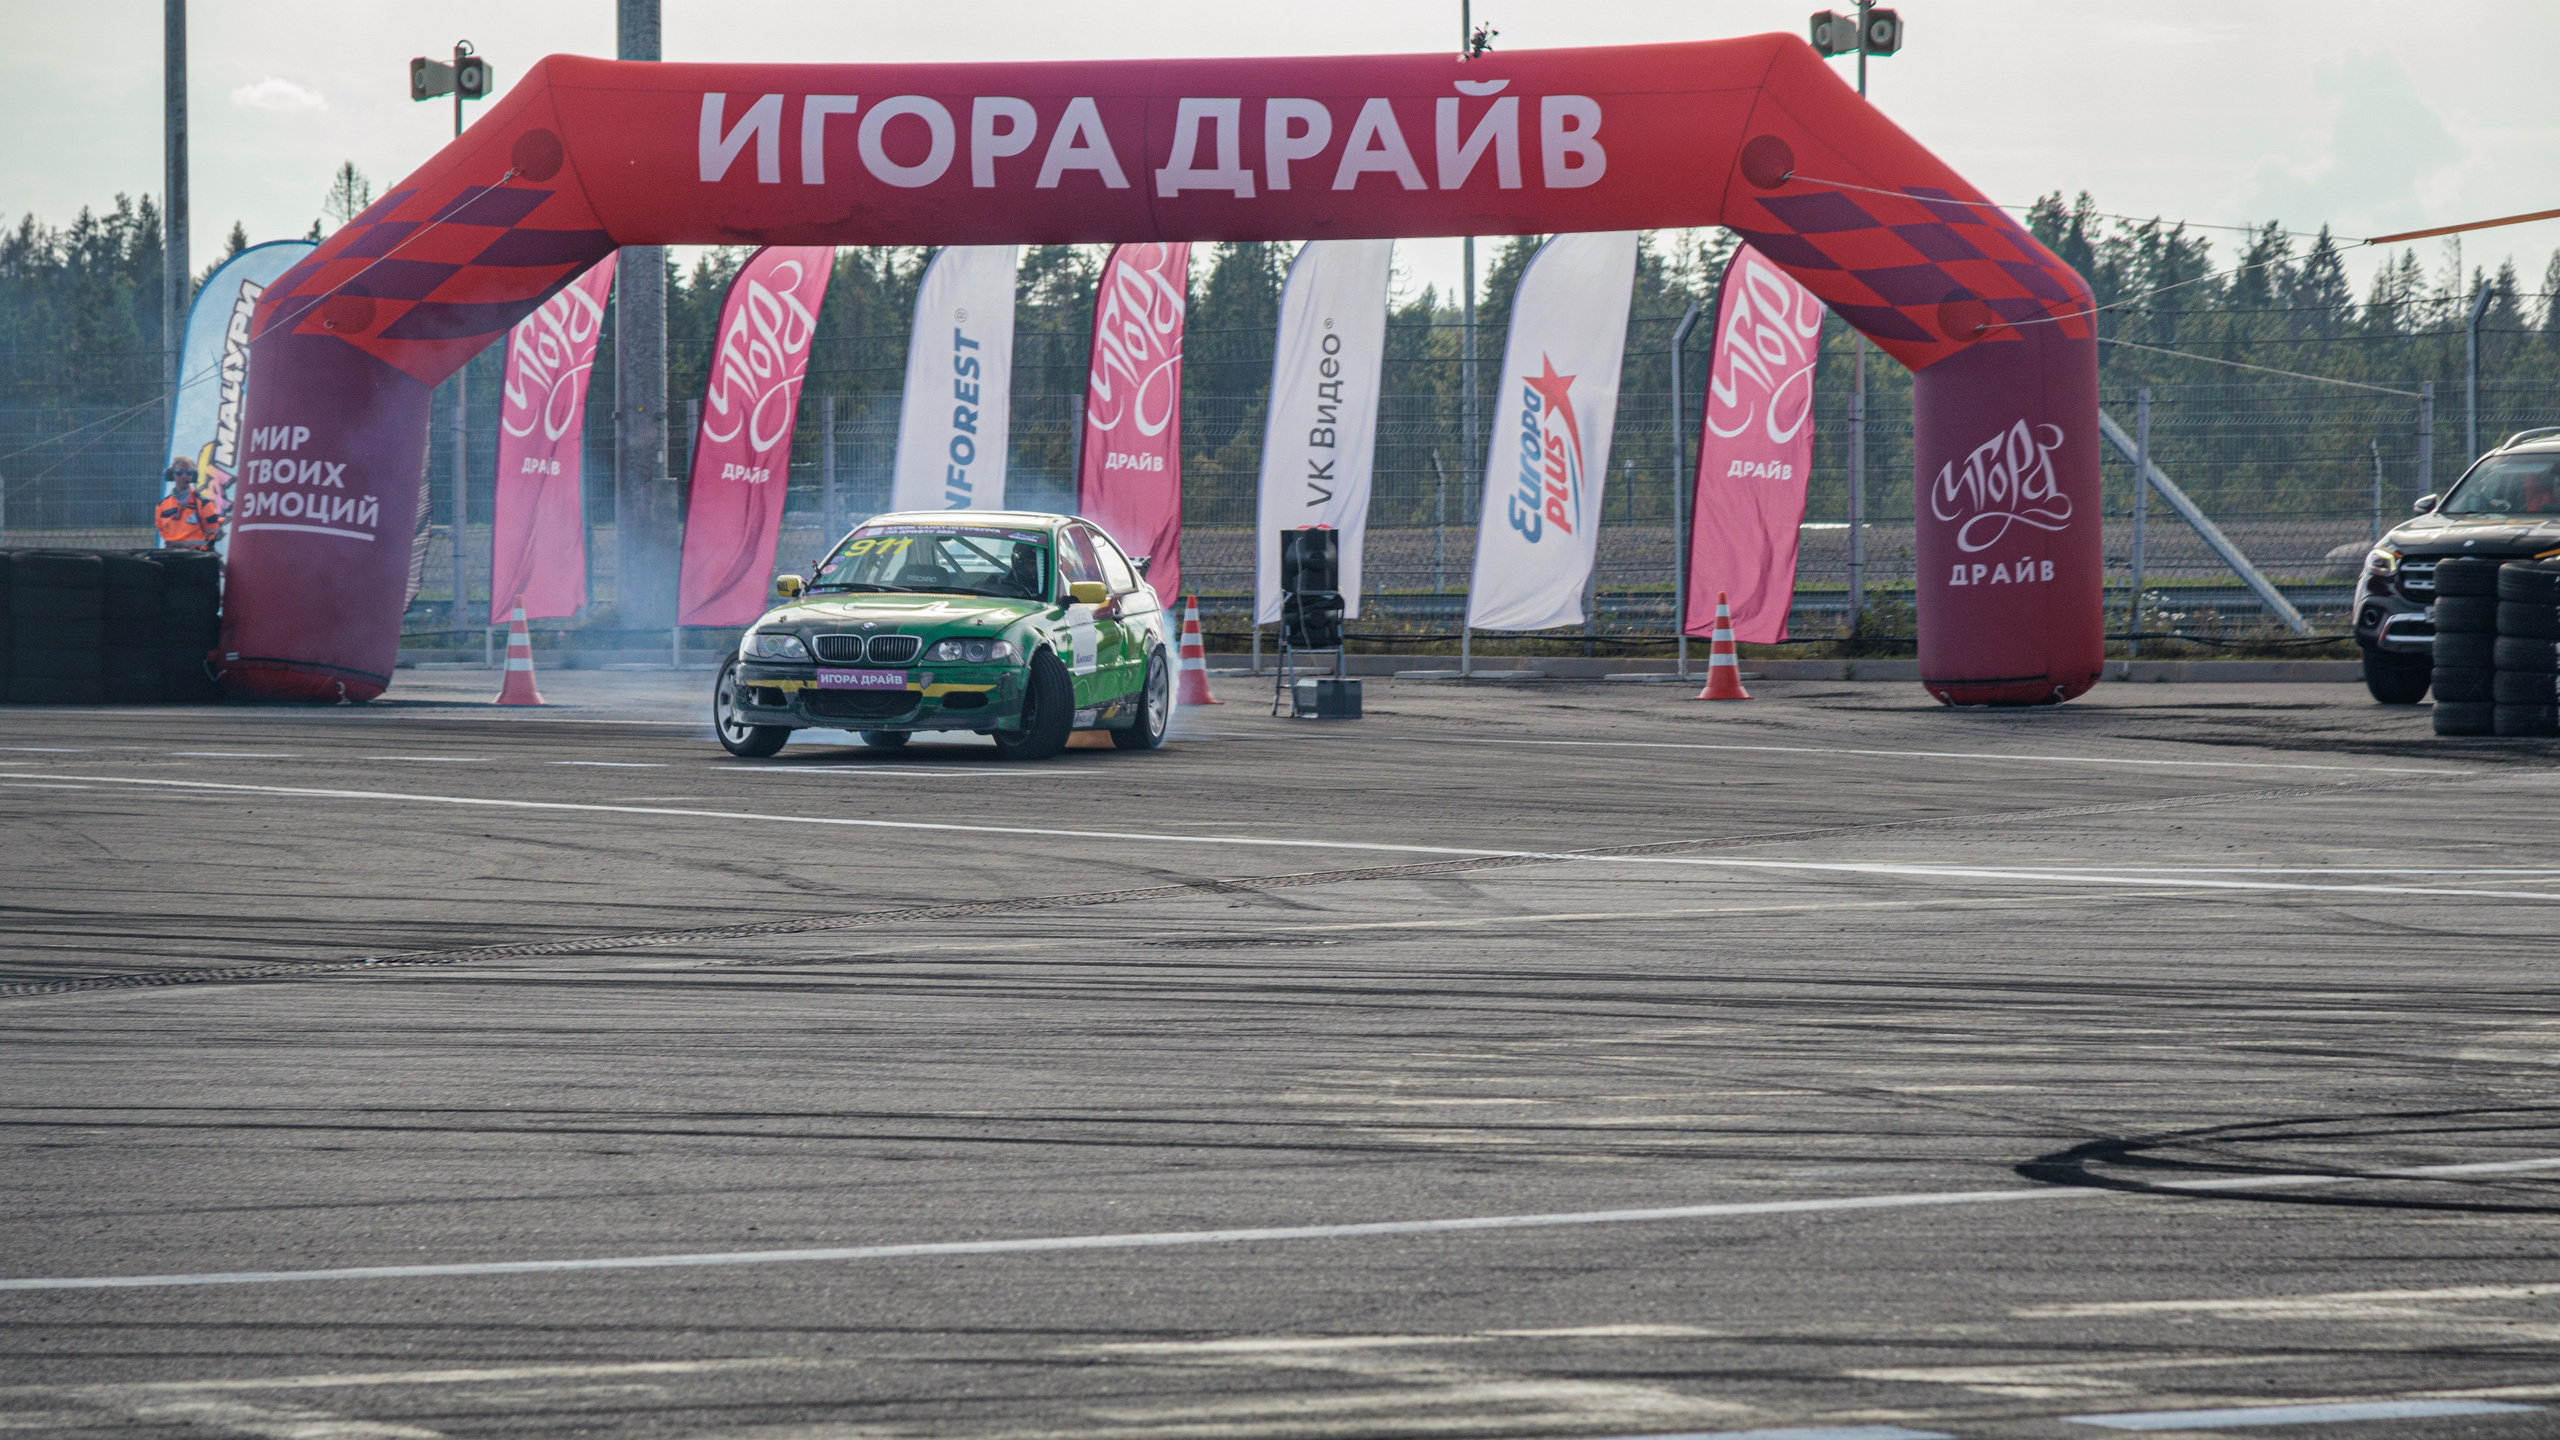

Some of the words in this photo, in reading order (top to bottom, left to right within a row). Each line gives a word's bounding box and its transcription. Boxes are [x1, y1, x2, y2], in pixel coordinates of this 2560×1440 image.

[699, 92, 1131, 188] ИГОРА
[1154, 79, 1607, 198] ДРАЙВ
[214, 279, 264, 468] МАЦУРИ
[944, 327, 980, 510] NFOREST
[250, 426, 311, 452] МИР
[247, 458, 347, 488] ТВОИХ
[521, 457, 561, 476] ДРАВ
[721, 462, 770, 484] ДРАЙВ
[1105, 452, 1164, 472] ДРАЙВ
[1727, 460, 1793, 481] ДРАЙВ
[1306, 458, 1335, 507] VK
[241, 491, 380, 528] ЭМОЦИЙ
[844, 538, 914, 557] 911
[1949, 556, 2055, 586] ДРАЙВ
[820, 674, 859, 685] ИГОРА
[860, 673, 903, 686] ДРАЙВ
